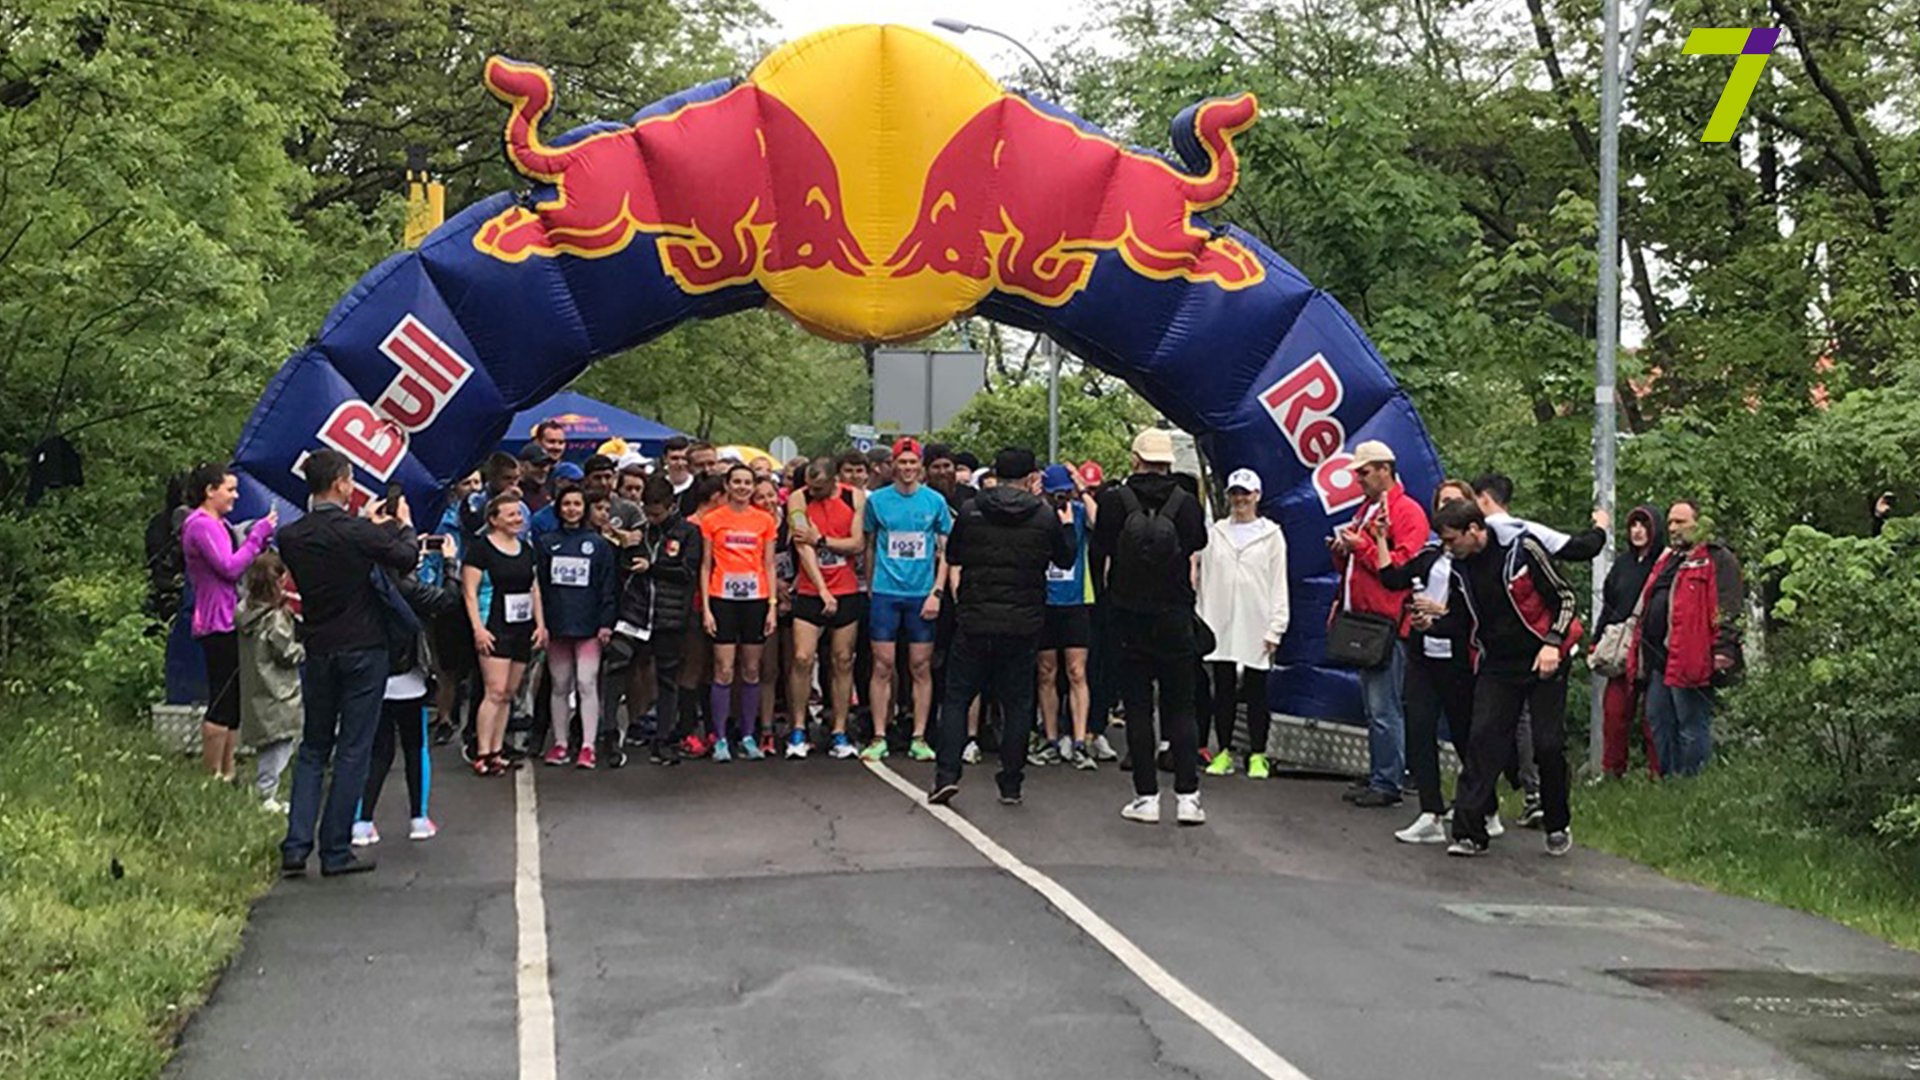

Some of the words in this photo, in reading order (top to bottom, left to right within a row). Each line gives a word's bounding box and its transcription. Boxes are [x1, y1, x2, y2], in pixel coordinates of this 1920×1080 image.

[318, 315, 473, 481] Bull
[892, 540, 924, 551] 1057
[553, 565, 587, 577] 1042
